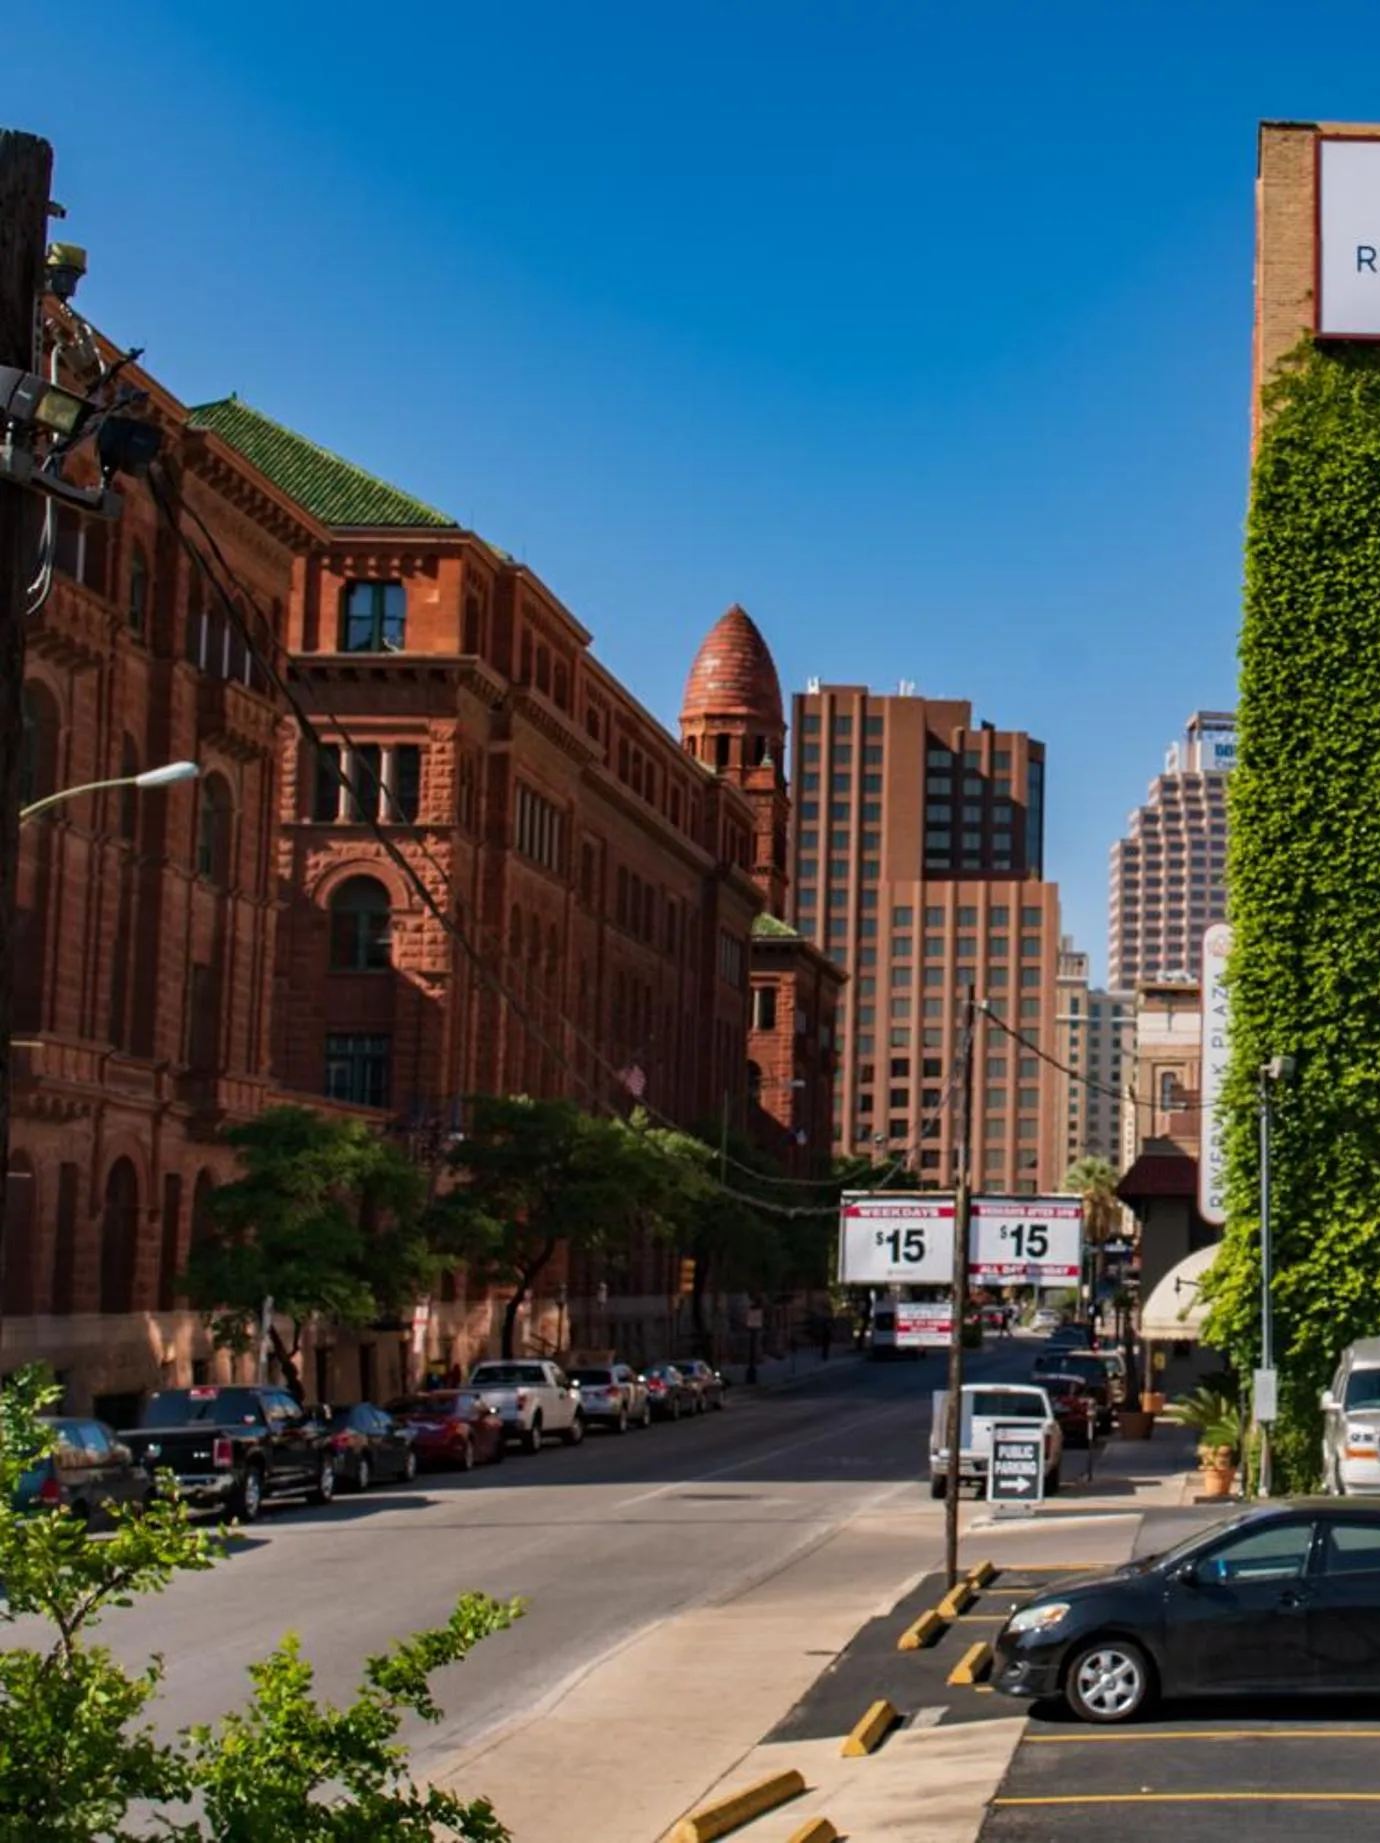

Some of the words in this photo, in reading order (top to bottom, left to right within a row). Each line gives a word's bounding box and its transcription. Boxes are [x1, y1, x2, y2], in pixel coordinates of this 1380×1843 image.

[859, 1207, 939, 1218] WEEKDAYS
[875, 1228, 926, 1264] $15
[1000, 1223, 1049, 1258] $15
[979, 1264, 999, 1275] ALL
[998, 1444, 1034, 1459] PUBLIC
[995, 1460, 1037, 1476] PARKING
